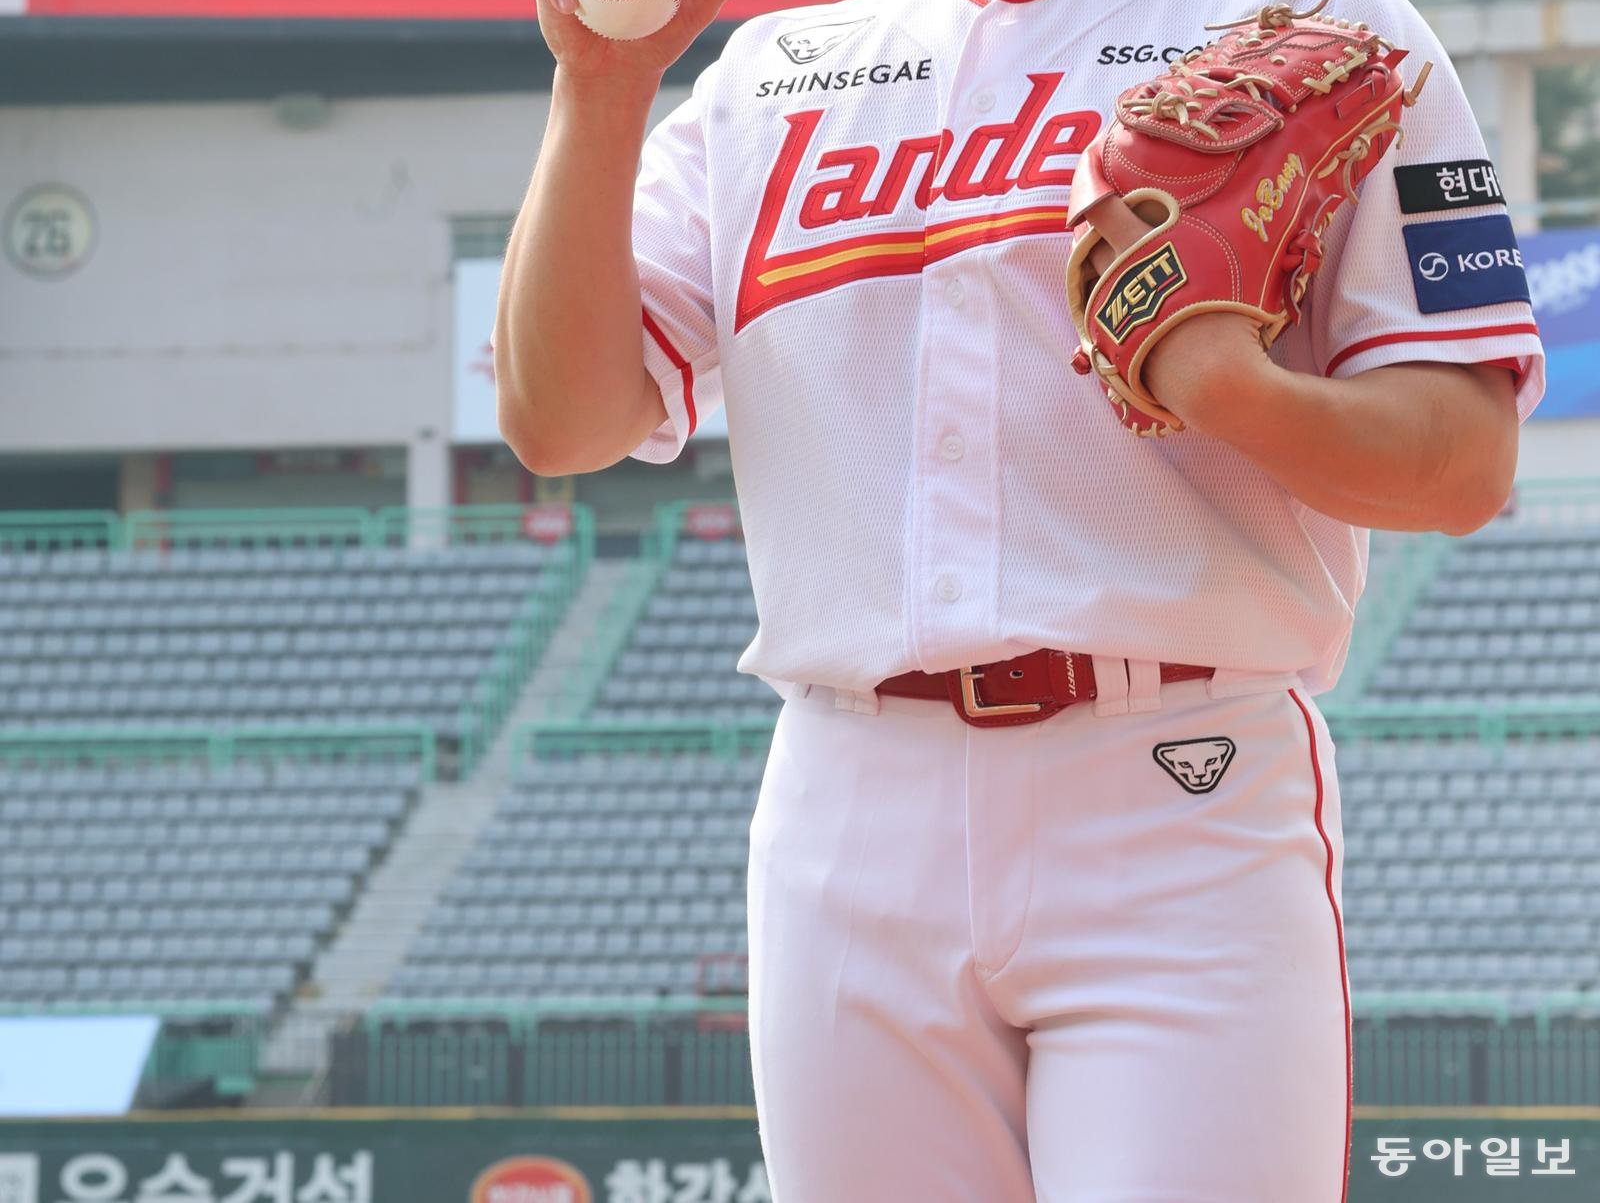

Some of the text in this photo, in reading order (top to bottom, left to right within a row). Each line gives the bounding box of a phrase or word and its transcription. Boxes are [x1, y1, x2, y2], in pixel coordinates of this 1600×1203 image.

[1097, 37, 1222, 65] SSG.C
[756, 58, 932, 98] SHINSEGAE
[1436, 166, 1501, 202] 현대
[1106, 251, 1175, 331] ZETT
